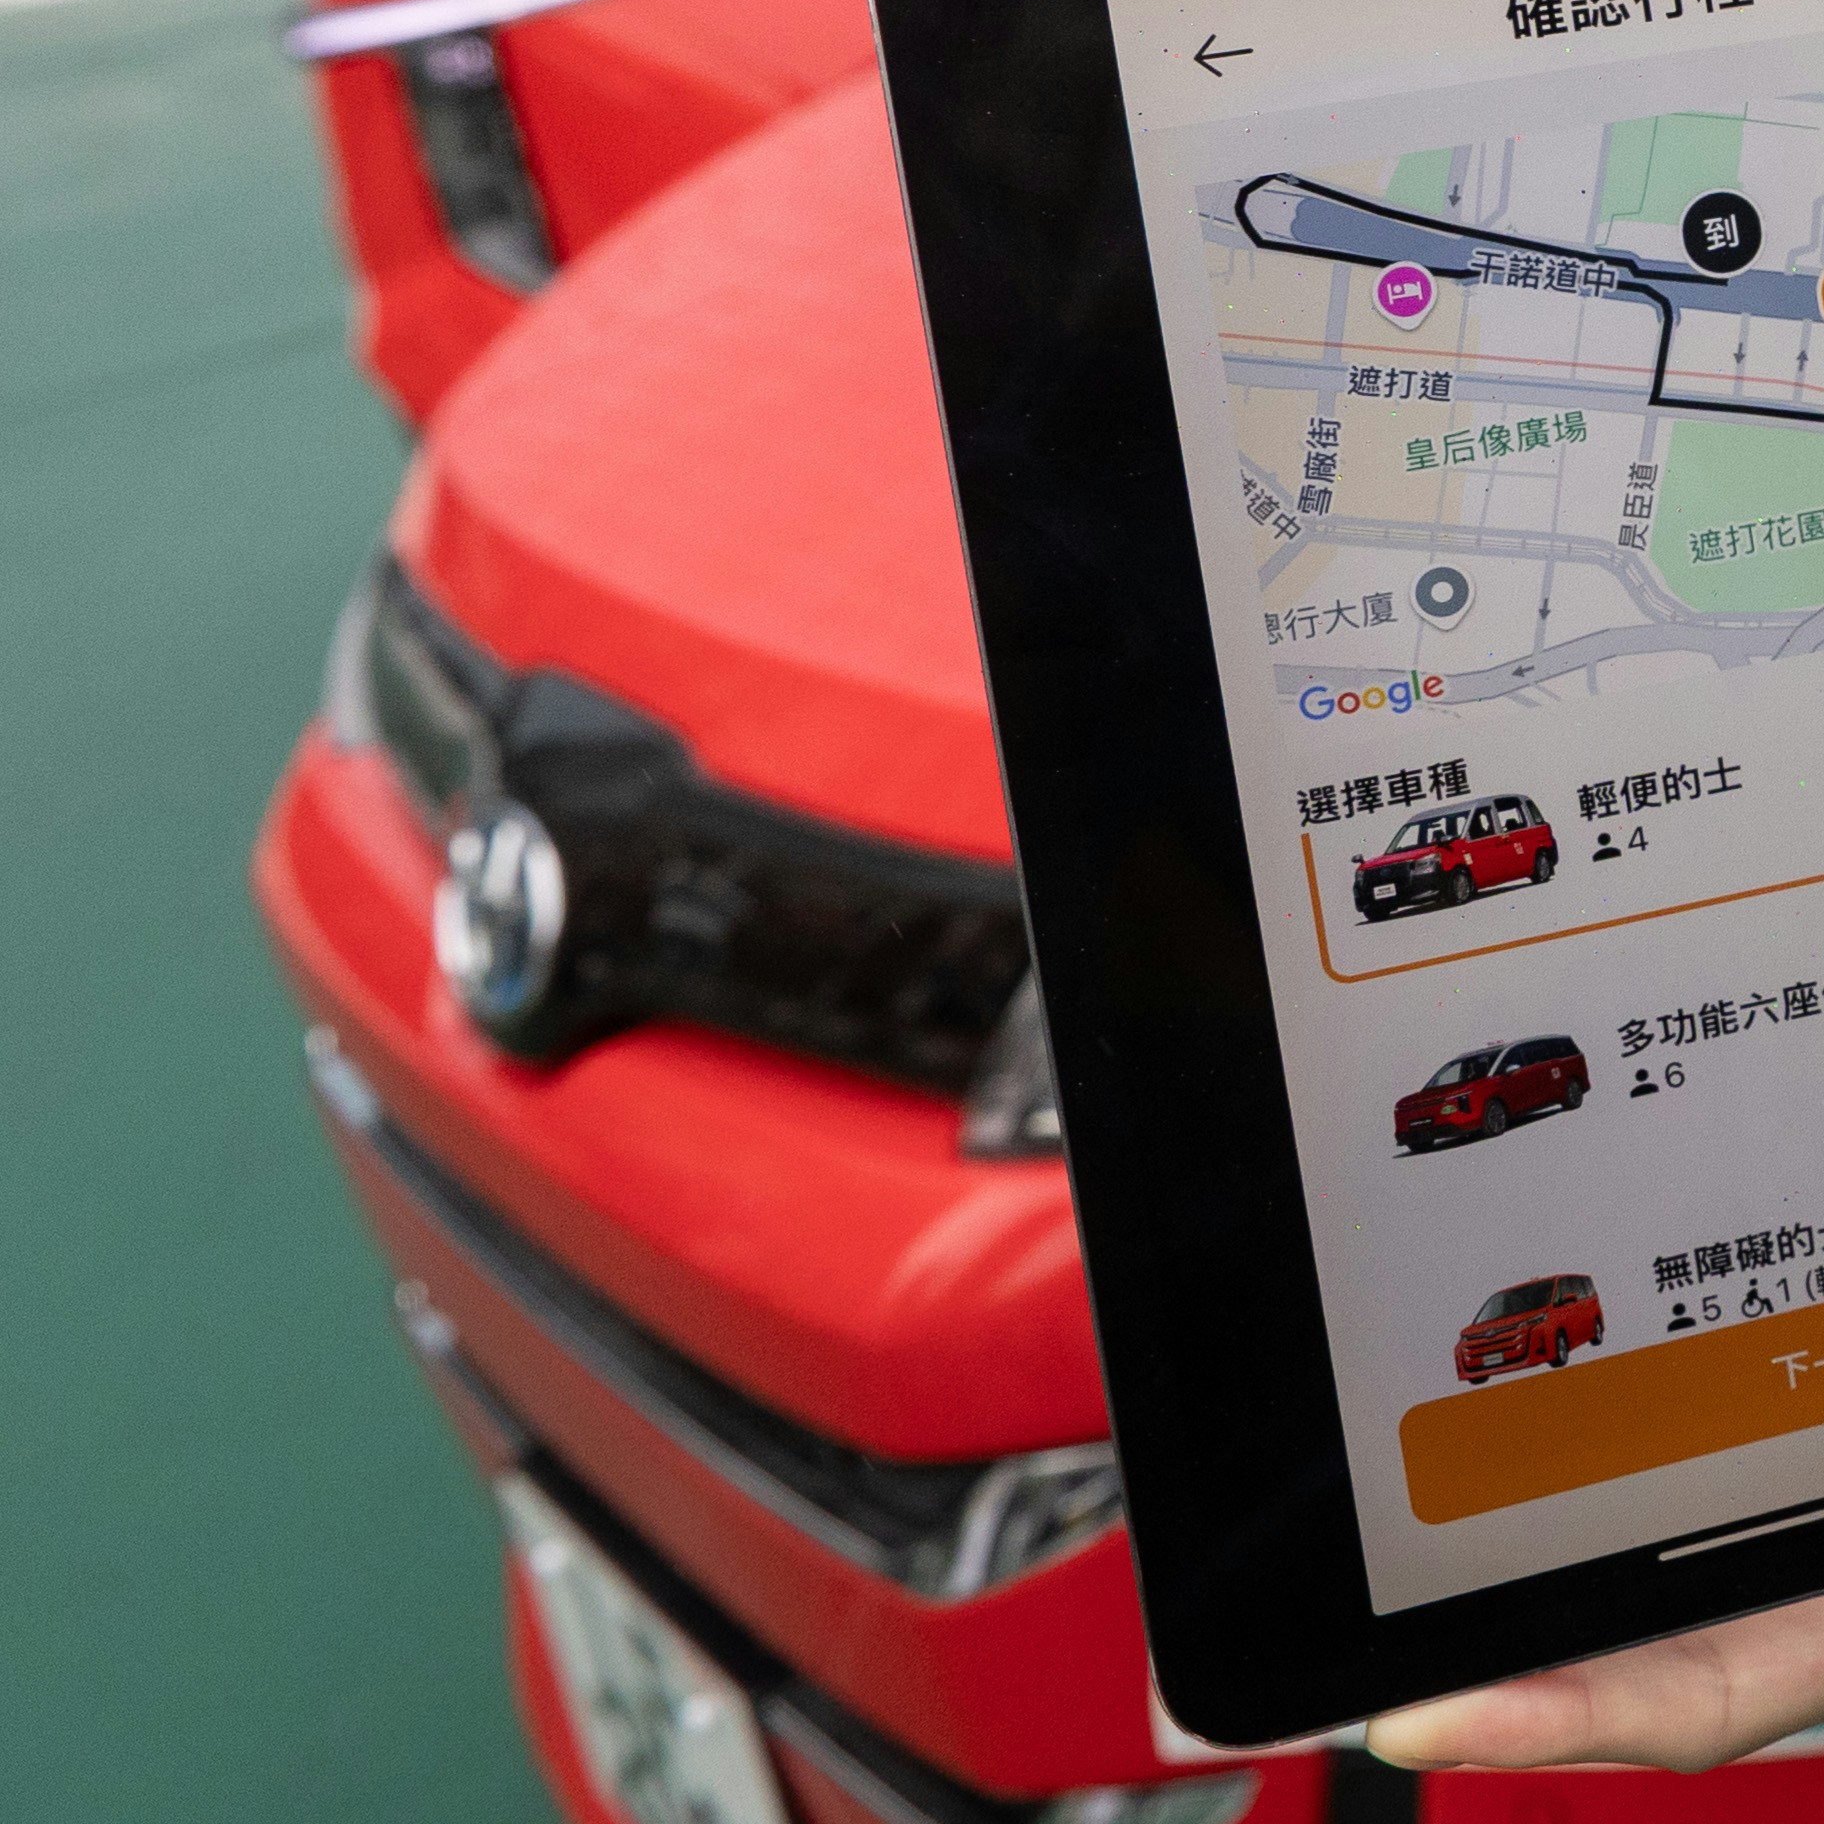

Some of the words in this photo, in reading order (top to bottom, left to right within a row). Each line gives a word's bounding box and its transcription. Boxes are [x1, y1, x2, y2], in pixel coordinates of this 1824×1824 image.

[1703, 214, 1740, 252] 到
[1470, 248, 1620, 298] 干諾道中
[1347, 364, 1454, 403] 遮打道
[1404, 410, 1588, 472] 皇后像廣場
[1297, 417, 1342, 516] 雪廠街
[1300, 669, 1446, 721] Google
[1296, 758, 1472, 827] 選擇車種
[1576, 756, 1743, 822] 輕便的士
[1627, 826, 1649, 853] 4
[1664, 1061, 1686, 1088] 6
[1701, 1296, 1723, 1323] 5
[1776, 1275, 1792, 1303] 1
